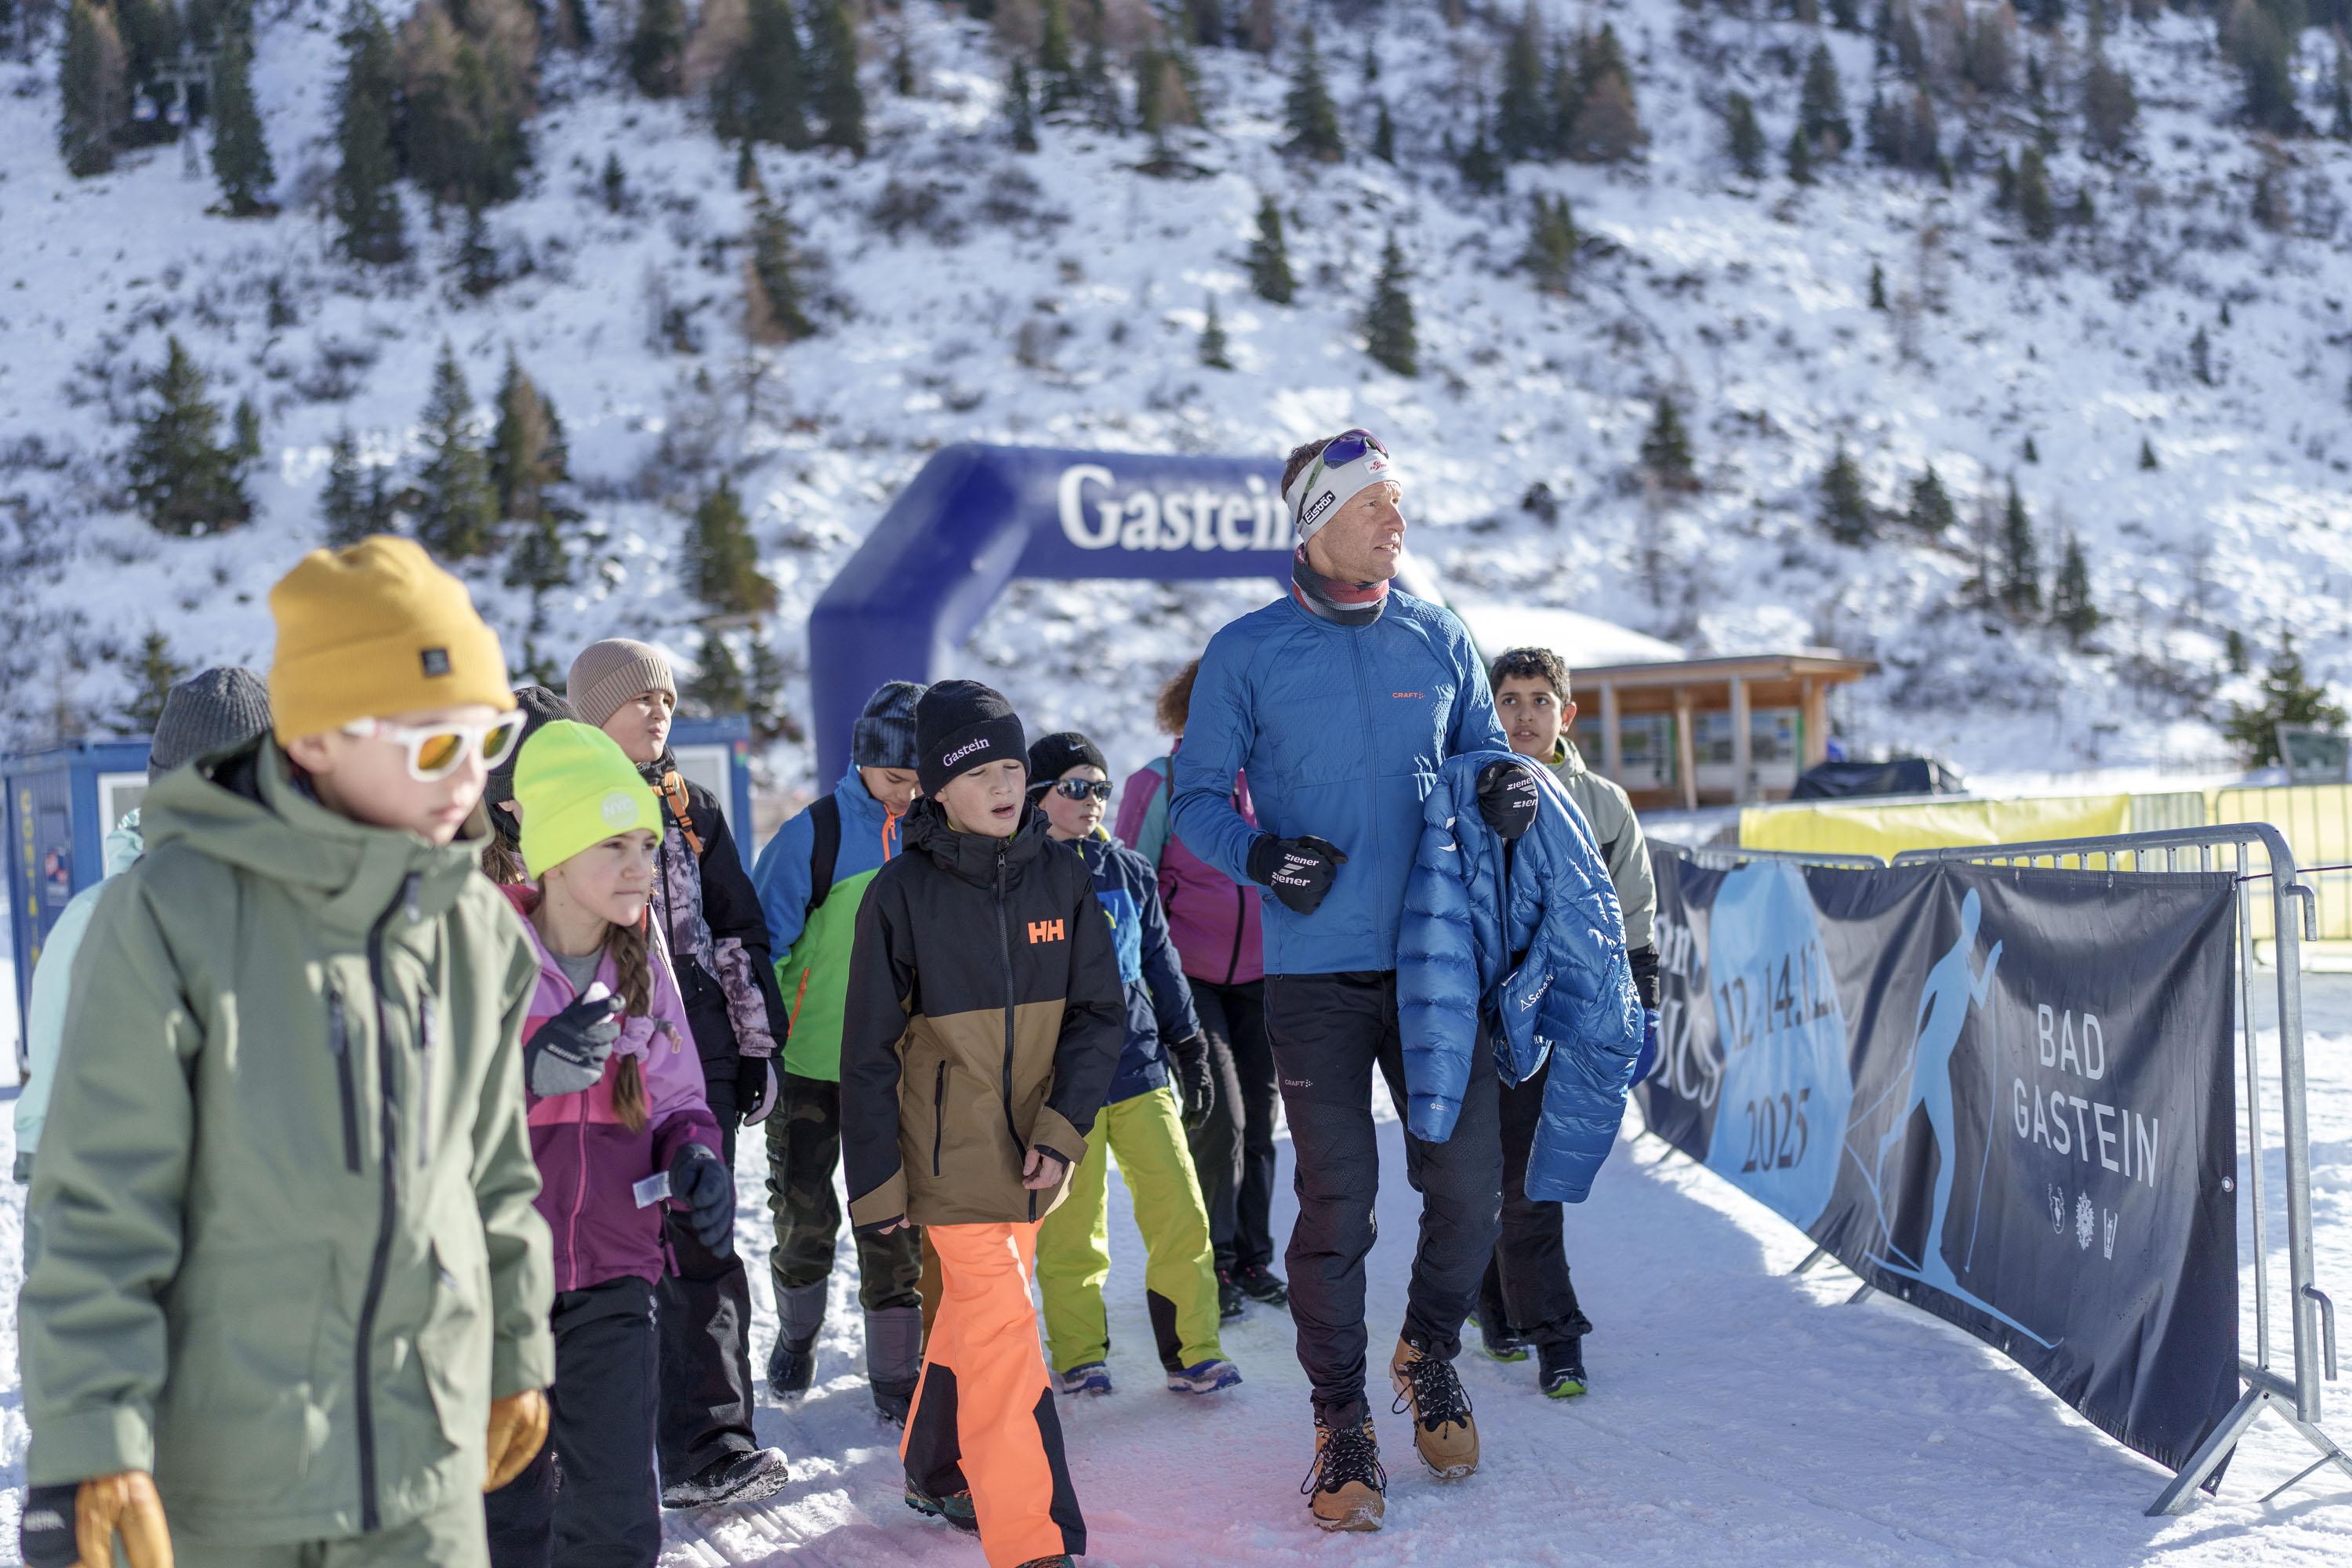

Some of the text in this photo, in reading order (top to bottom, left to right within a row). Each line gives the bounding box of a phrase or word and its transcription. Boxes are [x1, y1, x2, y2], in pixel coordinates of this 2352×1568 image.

[943, 738, 990, 767] Gastein
[1028, 918, 1065, 944] HH
[2038, 1003, 2105, 1080] BAD
[1284, 1079, 1305, 1087] CRAFT
[1741, 1087, 1812, 1174] 2025
[2013, 1077, 2158, 1188] GASTEIN
